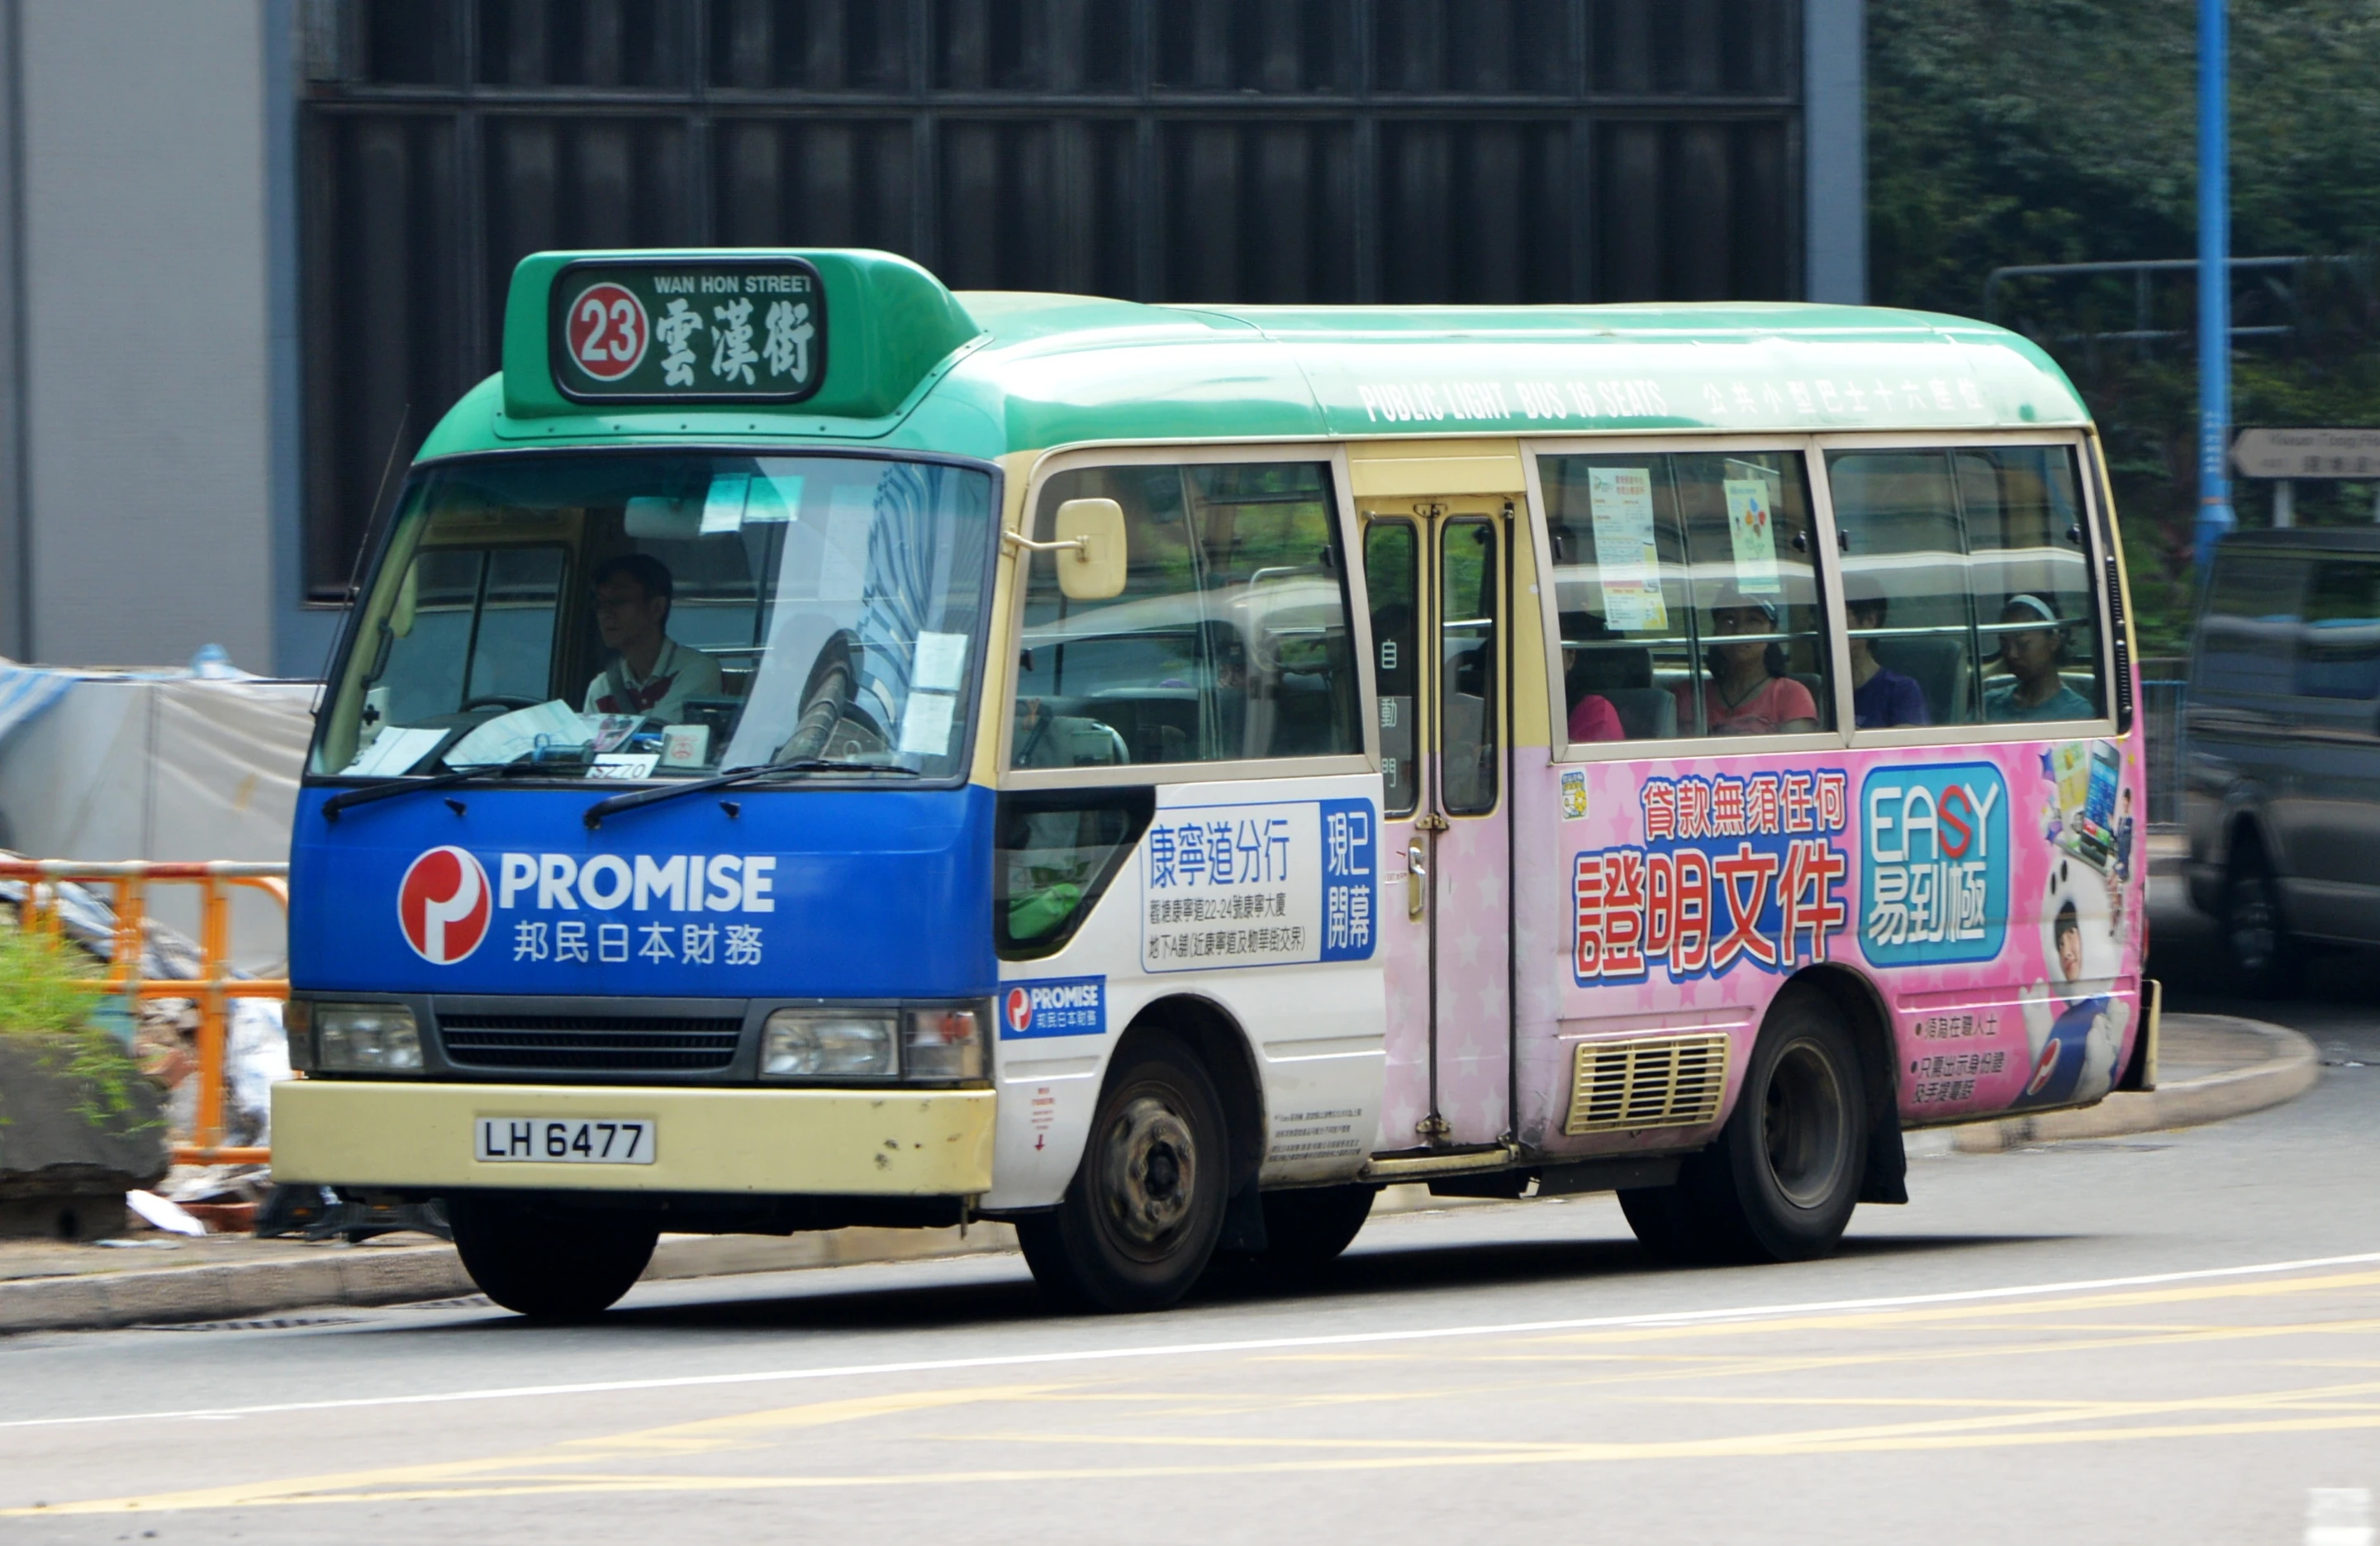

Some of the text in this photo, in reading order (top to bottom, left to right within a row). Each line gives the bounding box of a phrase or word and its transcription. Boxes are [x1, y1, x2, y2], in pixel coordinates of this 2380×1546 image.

[653, 274, 811, 293] WAN HON STREET
[581, 298, 637, 361] 23
[655, 297, 815, 387] 雲漢街
[1357, 379, 1669, 422] PUBLIC LIGHT BUS 16 SEATS
[1643, 772, 1847, 841] 貸款無須任何
[1869, 782, 2000, 863] EASY
[499, 852, 777, 912] PROMISE
[1149, 819, 1290, 889] 康寧道分行
[1328, 885, 1371, 949] 開幕
[1575, 838, 1846, 978] 證明文件
[513, 920, 764, 966] 邦民日本財務
[1030, 985, 1099, 1010] PROMISE
[486, 1122, 644, 1158] LH 6477
